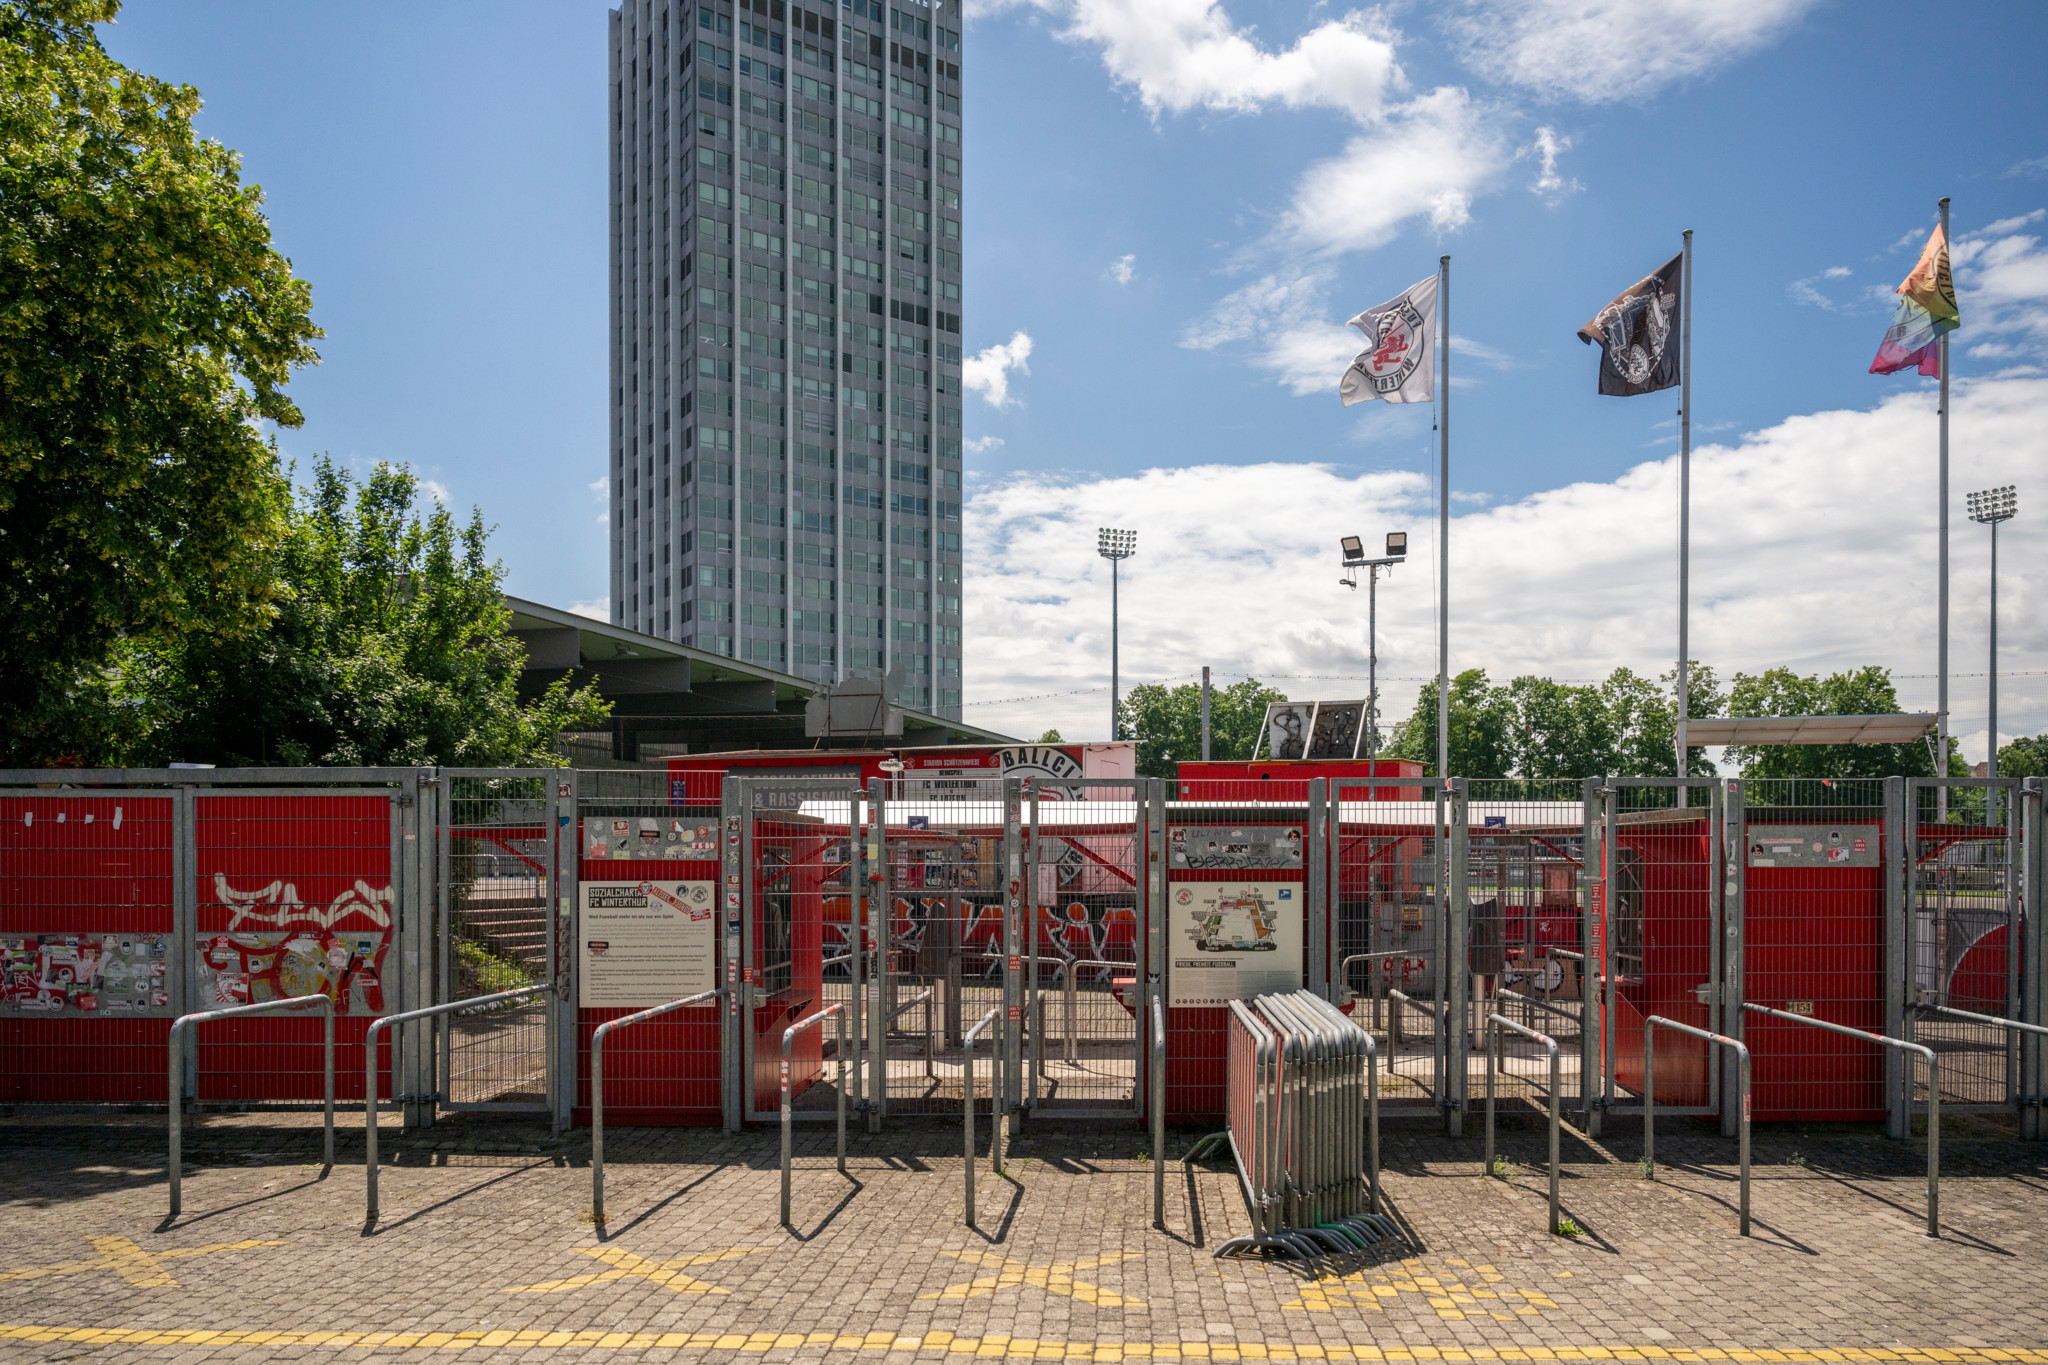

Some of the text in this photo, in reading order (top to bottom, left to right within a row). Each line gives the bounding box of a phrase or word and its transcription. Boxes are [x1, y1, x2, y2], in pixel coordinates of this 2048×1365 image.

[922, 779, 931, 789] FC
[754, 792, 763, 806] &
[590, 898, 647, 907] FC WINTERTHUR
